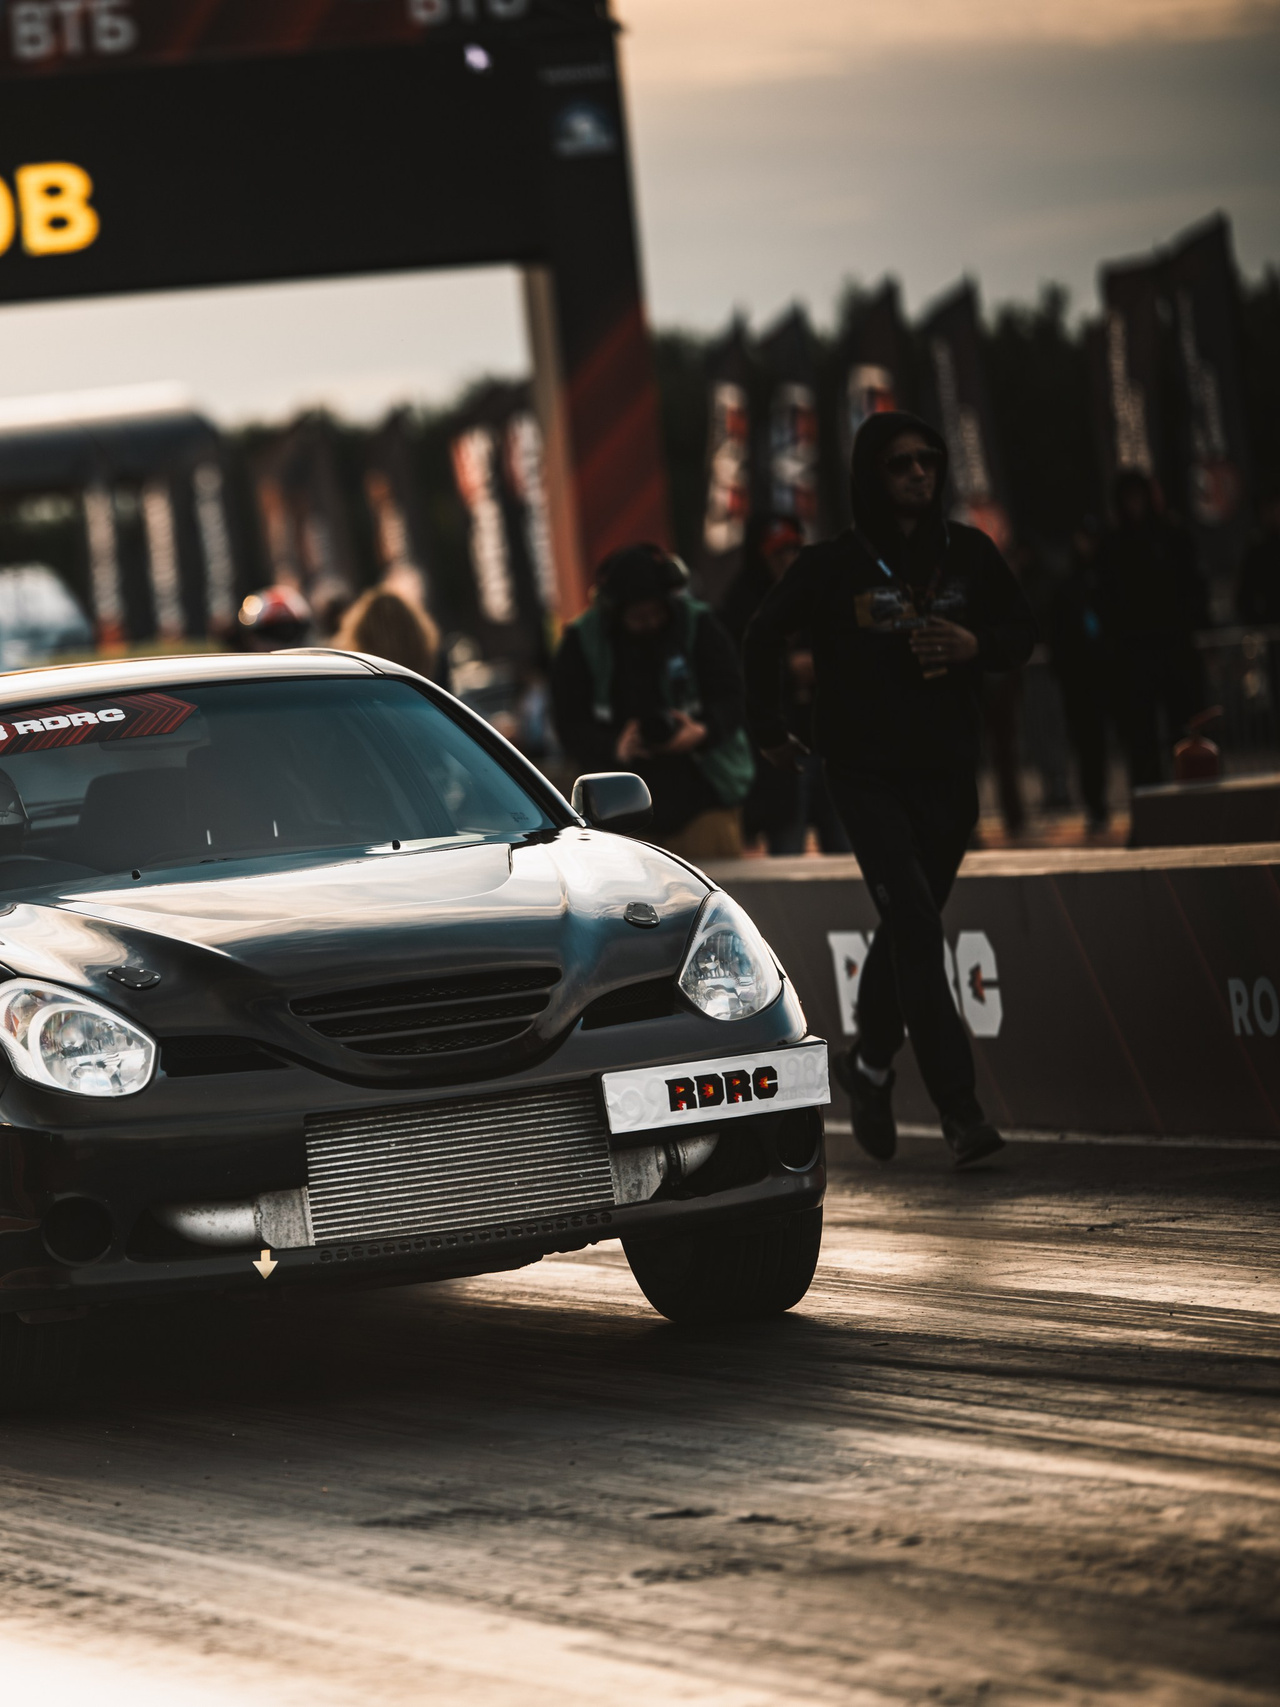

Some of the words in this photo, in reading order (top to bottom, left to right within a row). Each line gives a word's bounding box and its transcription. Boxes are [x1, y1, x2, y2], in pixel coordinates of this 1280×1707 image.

[11, 0, 135, 61] ВТБ
[11, 708, 126, 736] RDRC
[827, 930, 1004, 1039] RC
[665, 1065, 779, 1113] RDRC
